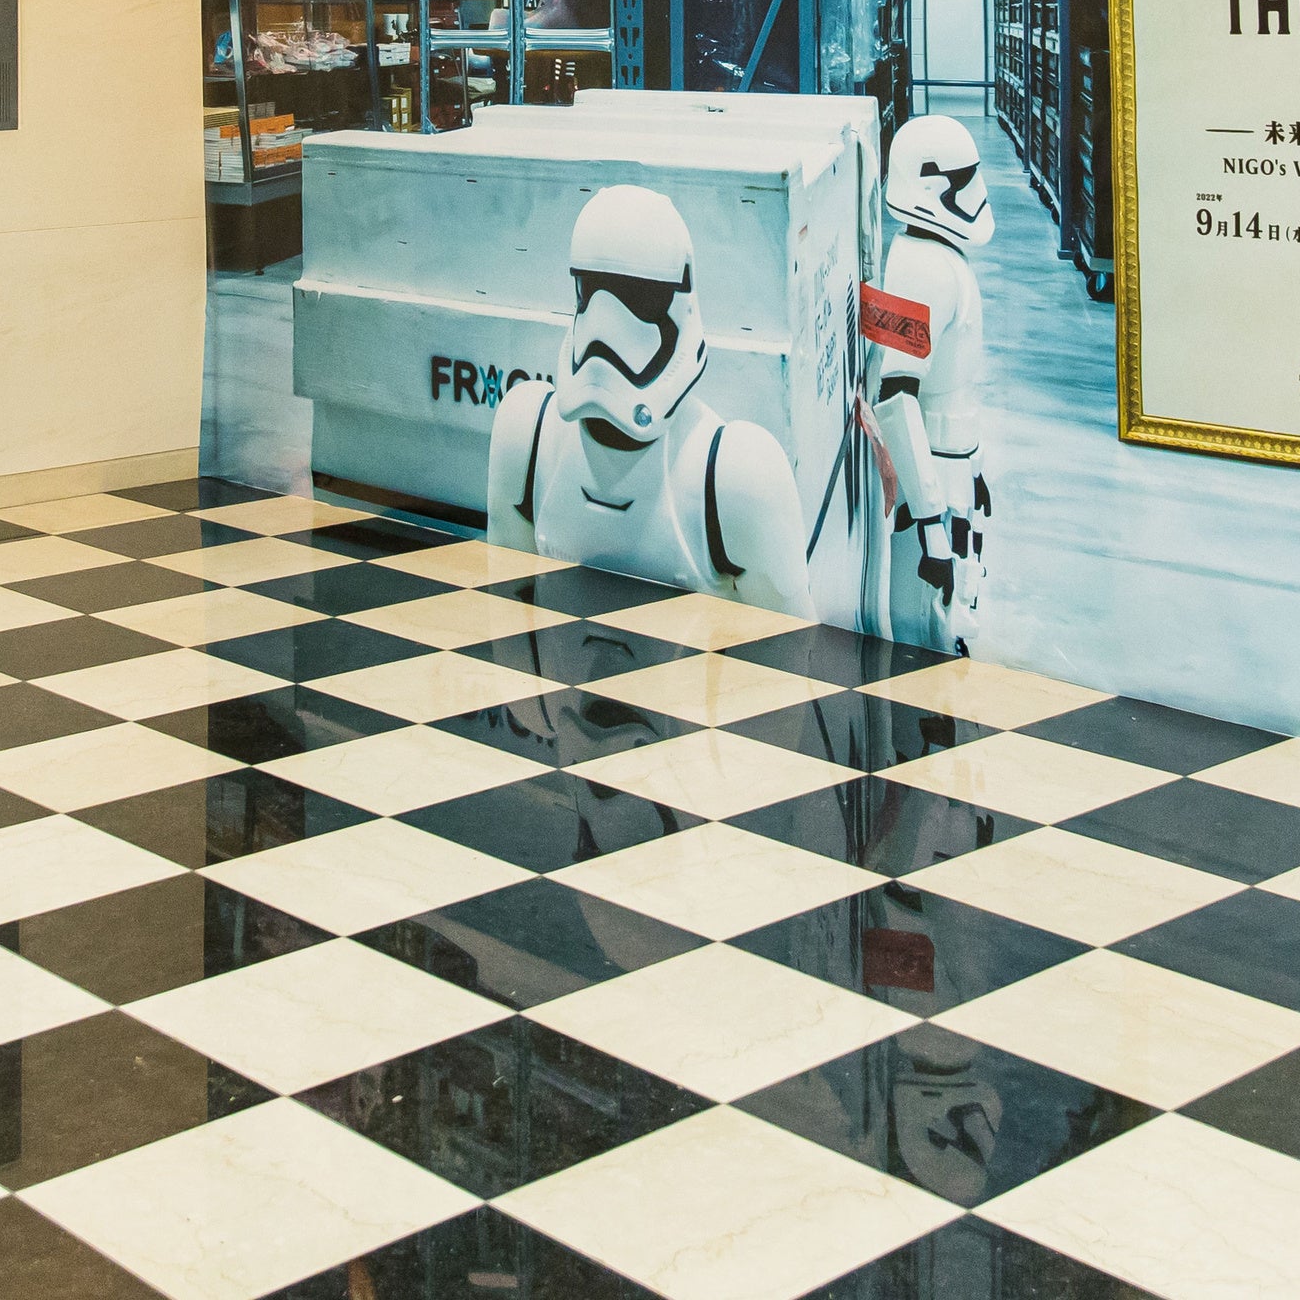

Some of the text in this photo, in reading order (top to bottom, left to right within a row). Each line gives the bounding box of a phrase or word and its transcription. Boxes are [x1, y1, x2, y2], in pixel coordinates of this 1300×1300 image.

[1223, 158, 1286, 176] NIGO's
[1196, 193, 1222, 202] 2022年
[431, 356, 553, 405] FRA
